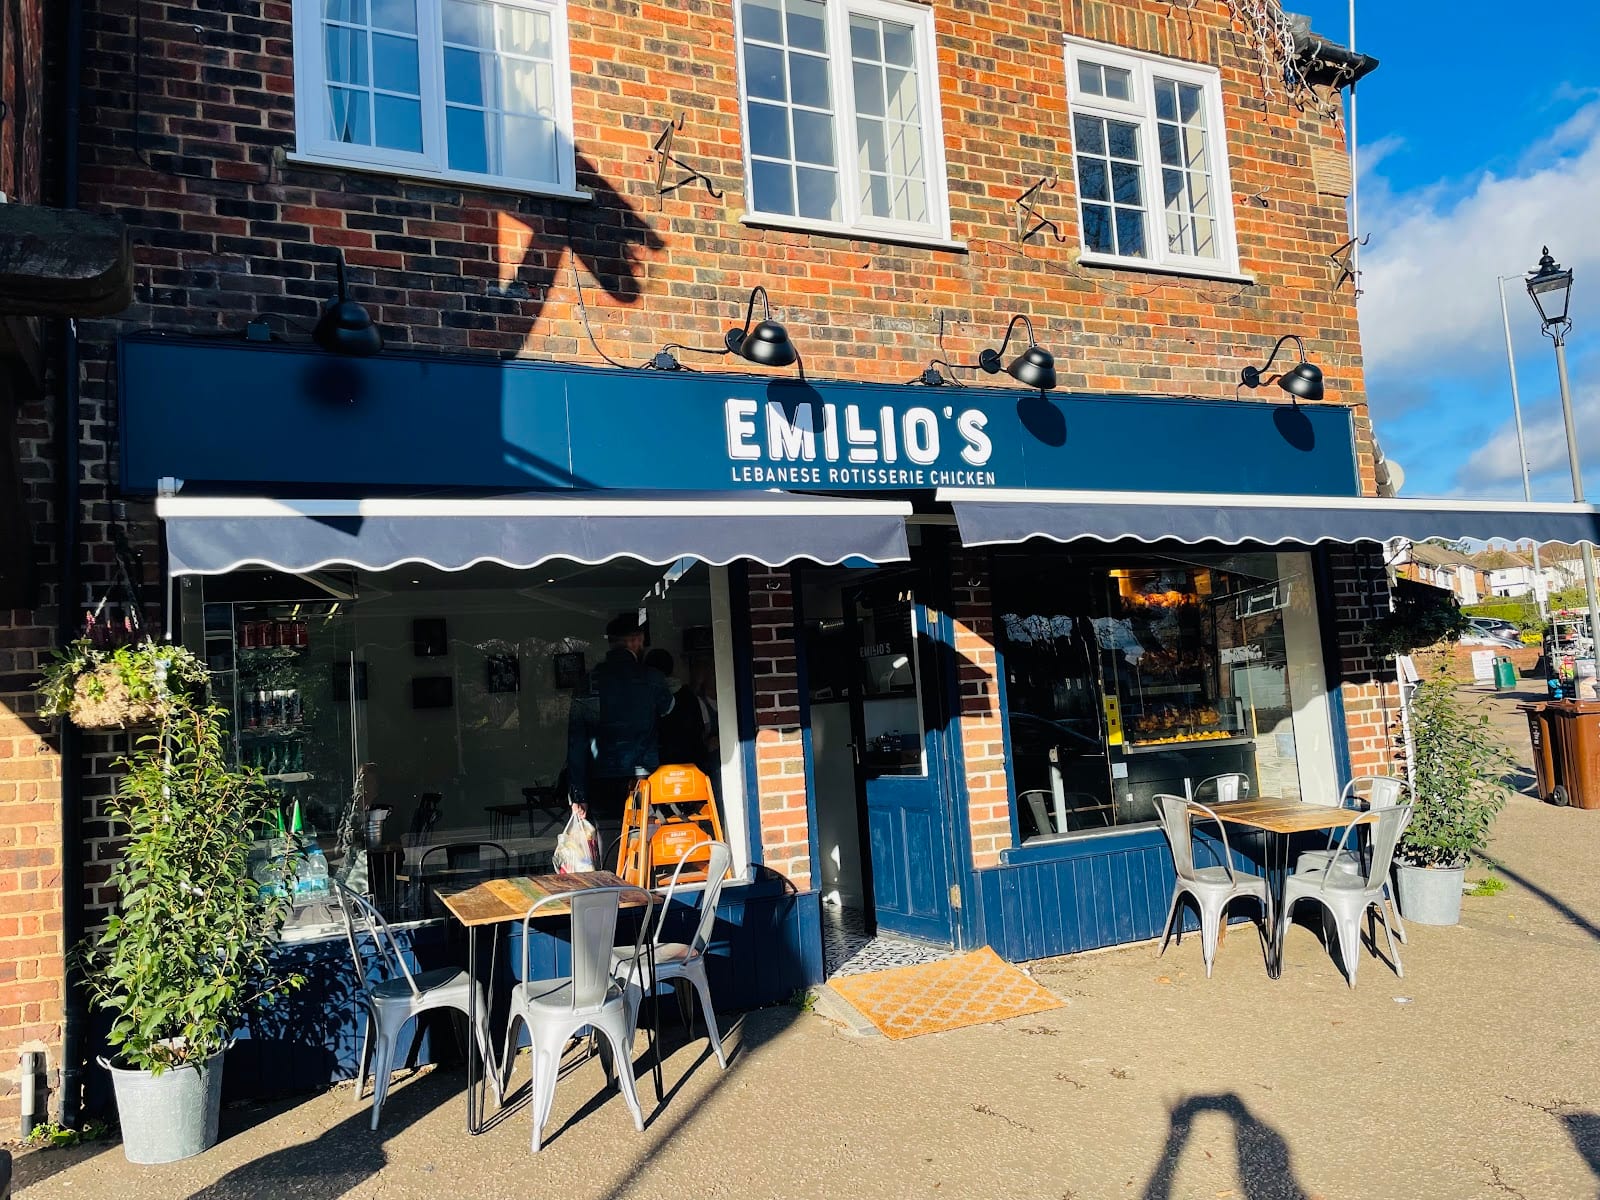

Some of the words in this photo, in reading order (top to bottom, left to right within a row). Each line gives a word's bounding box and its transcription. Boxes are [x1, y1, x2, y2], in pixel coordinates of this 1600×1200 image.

[725, 398, 993, 466] EMILIO'S
[731, 466, 821, 483] LEBANESE
[829, 468, 924, 485] ROTISSERIE
[930, 470, 996, 486] CHICKEN
